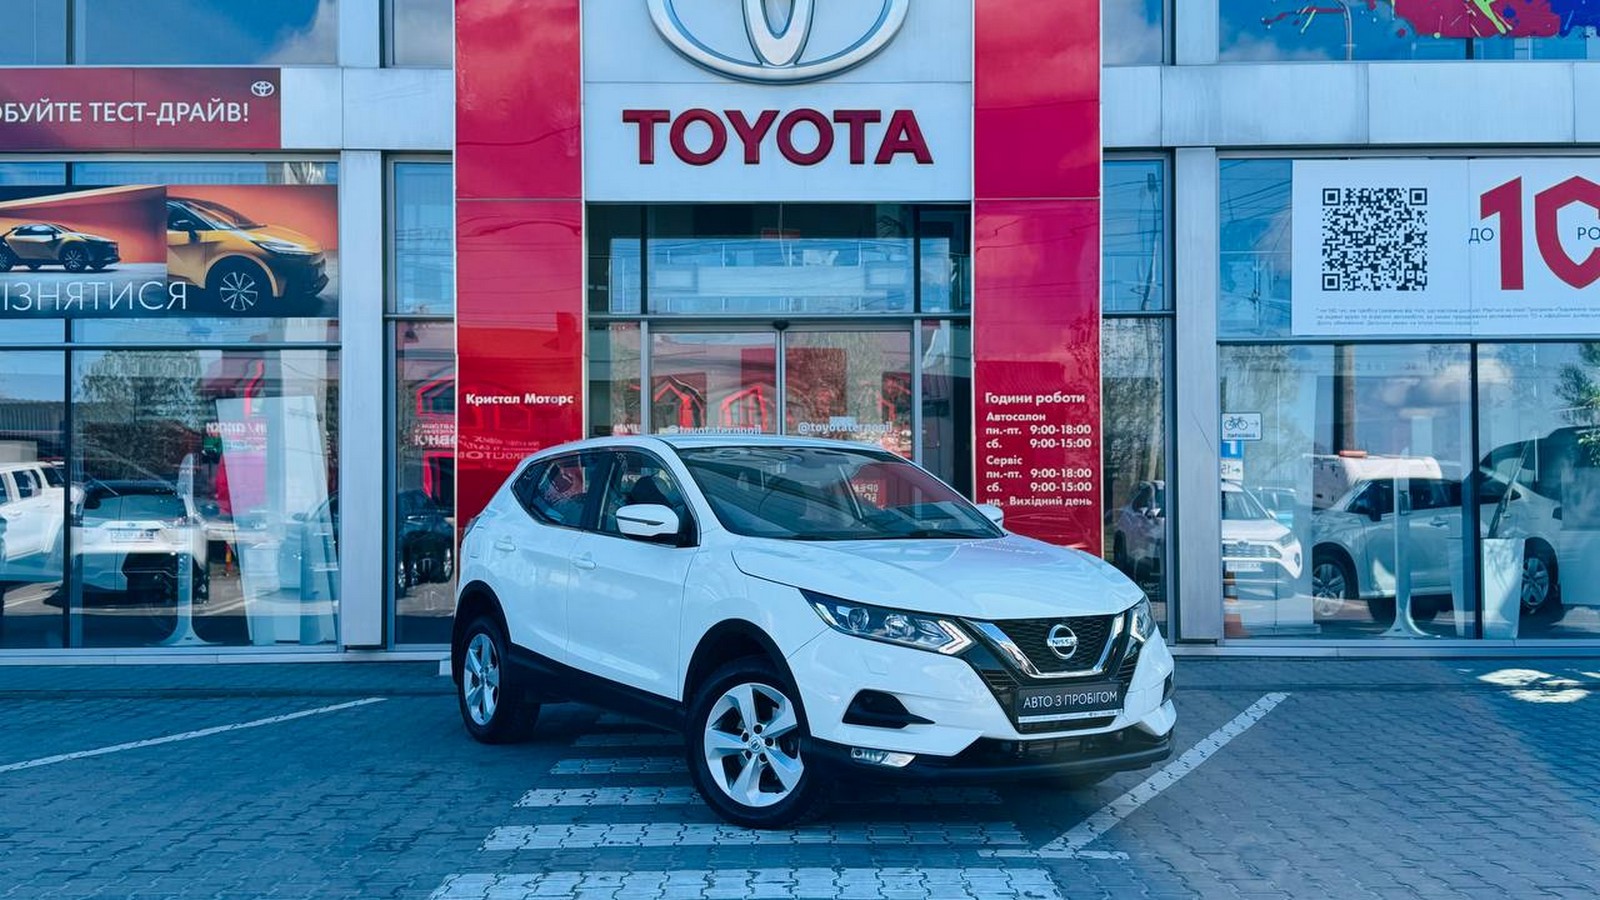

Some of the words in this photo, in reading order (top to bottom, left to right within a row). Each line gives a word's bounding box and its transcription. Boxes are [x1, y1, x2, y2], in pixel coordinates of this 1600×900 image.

[0, 98, 82, 122] БУЙТЕ
[89, 98, 249, 125] ТЕСТ-ДРАЙВ!
[622, 108, 935, 166] TOYOTA
[1468, 227, 1495, 245] ДО
[1480, 175, 1600, 290] 10
[4, 281, 187, 311] ІЗНЯТИСЯ
[466, 393, 520, 407] Кристал
[524, 393, 574, 406] Моторс
[985, 392, 1033, 406] Години
[1035, 391, 1085, 407] роботи
[986, 412, 1046, 422] Автосалон
[985, 427, 1022, 435] пн.-пт.
[1029, 424, 1092, 435] 9:00-18:00
[986, 438, 1002, 449] сб.
[1029, 438, 1092, 449] 9:00-15:00
[986, 455, 1023, 468] Сервіс
[986, 471, 1023, 479] пн.-пт.
[1030, 468, 1092, 479] 9:00-18:00
[986, 482, 1003, 492] сб.
[1030, 482, 1092, 492] 9:00-15:00
[1009, 496, 1062, 507] Вихідний
[1065, 498, 1092, 507] день
[1023, 695, 1053, 709] АВТО
[1054, 694, 1062, 707] З
[1064, 691, 1118, 706] ПРОБІГОМ
